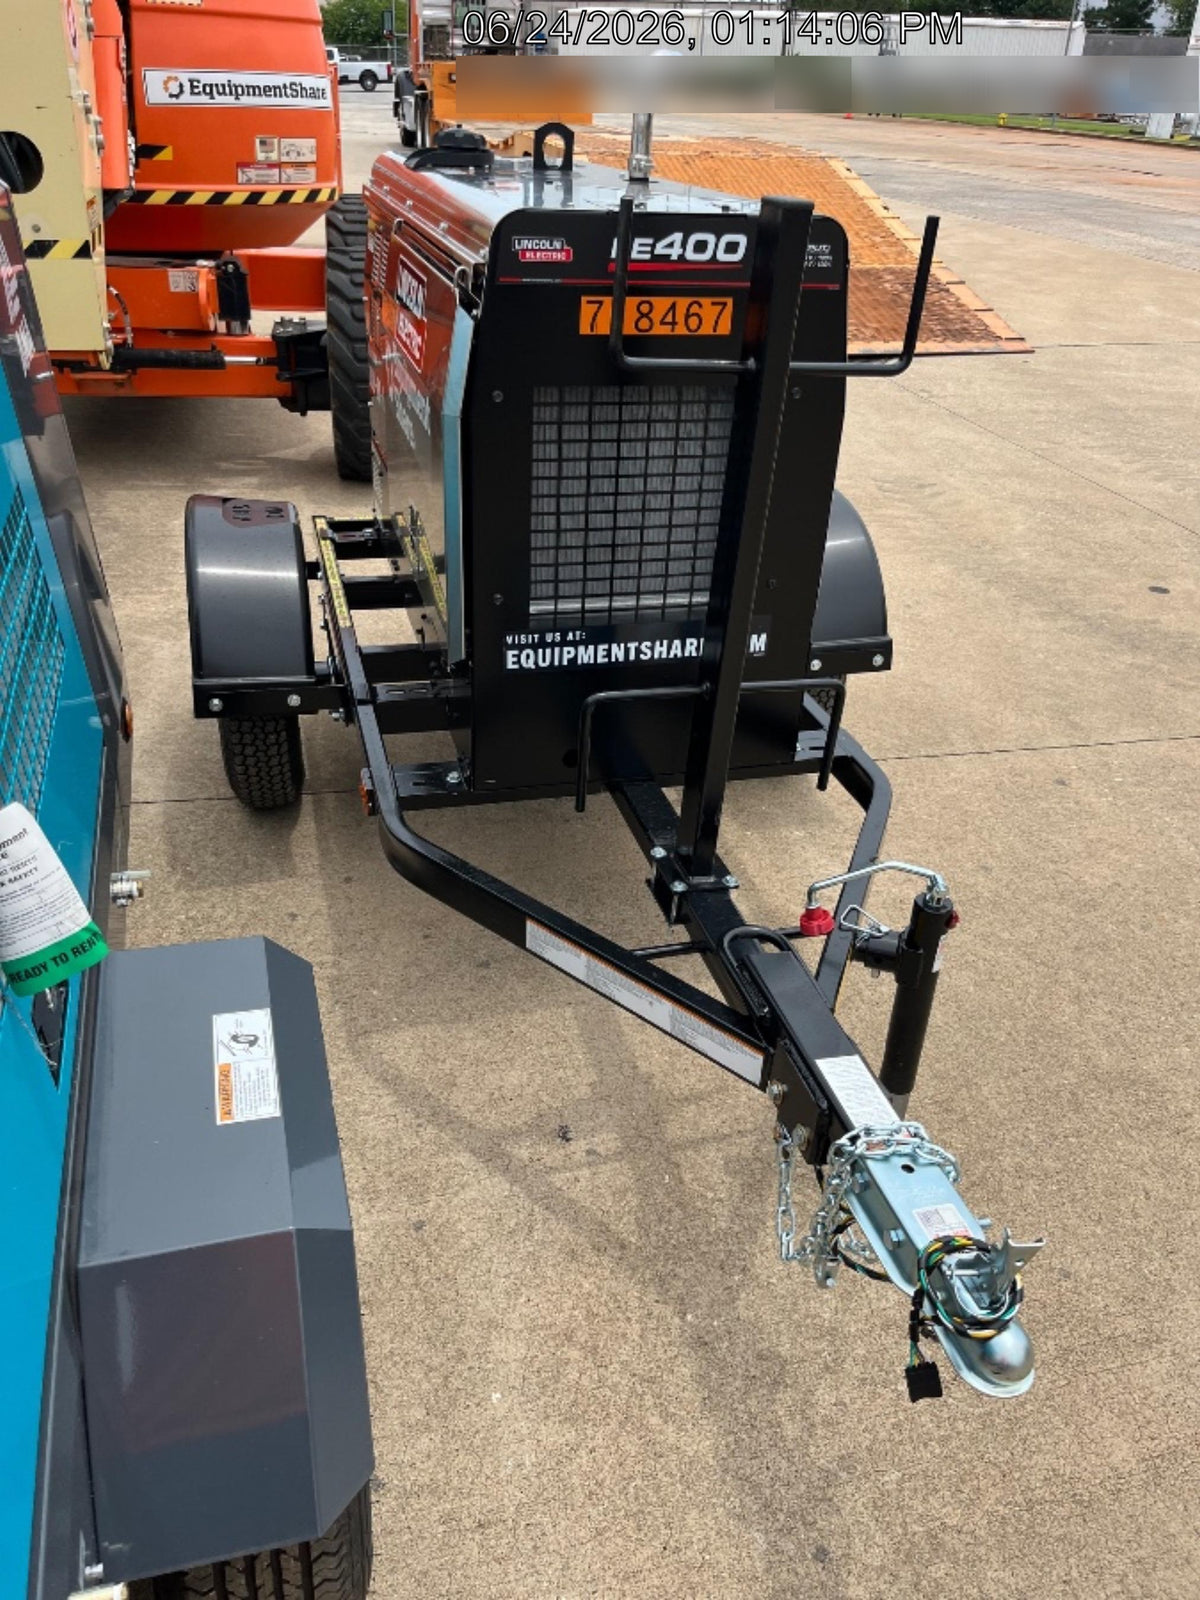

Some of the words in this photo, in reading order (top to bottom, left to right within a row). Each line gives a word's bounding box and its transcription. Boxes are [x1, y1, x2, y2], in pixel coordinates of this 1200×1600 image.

[188, 78, 327, 101] EquipmentShare
[514, 239, 562, 250] LINCOLN
[525, 251, 567, 260] ELECTRIC
[506, 634, 539, 645] VISIT
[545, 632, 561, 643] US
[567, 631, 586, 642] AT:
[8, 961, 49, 986] READY
[51, 951, 69, 969] TO
